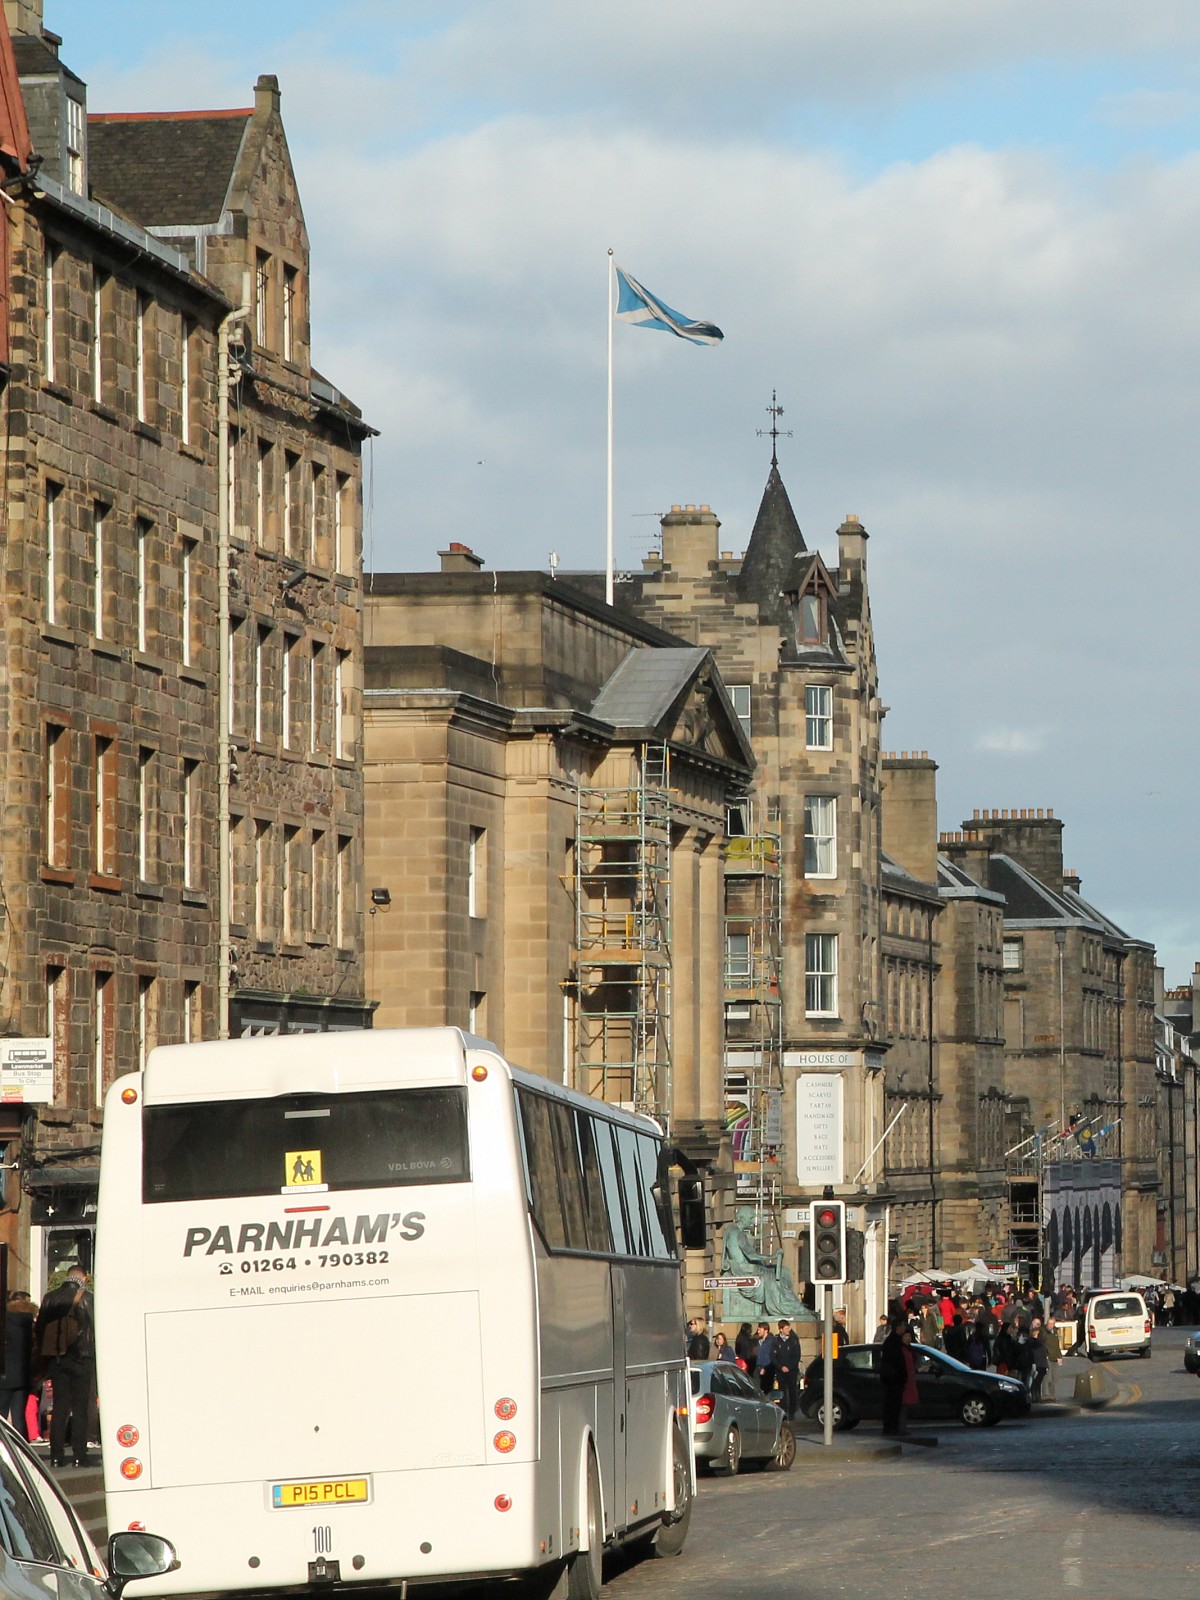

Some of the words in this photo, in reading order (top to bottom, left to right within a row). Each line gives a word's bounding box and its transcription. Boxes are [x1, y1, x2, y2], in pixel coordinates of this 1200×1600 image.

[799, 1054, 835, 1064] HOUSE
[838, 1054, 849, 1064] OF
[26, 1070, 41, 1078] Stop
[388, 1162, 408, 1171] VDL
[410, 1160, 436, 1170] BOVA
[182, 1211, 427, 1258] PARNHAM'S
[240, 1257, 297, 1274] 01264
[318, 1250, 390, 1268] 790382
[229, 1286, 265, 1297] E-MAIL
[268, 1276, 390, 1295] enquiries@parnhams.com
[293, 1485, 318, 1502] P15
[323, 1483, 355, 1499] PCL
[312, 1525, 332, 1554] 100
